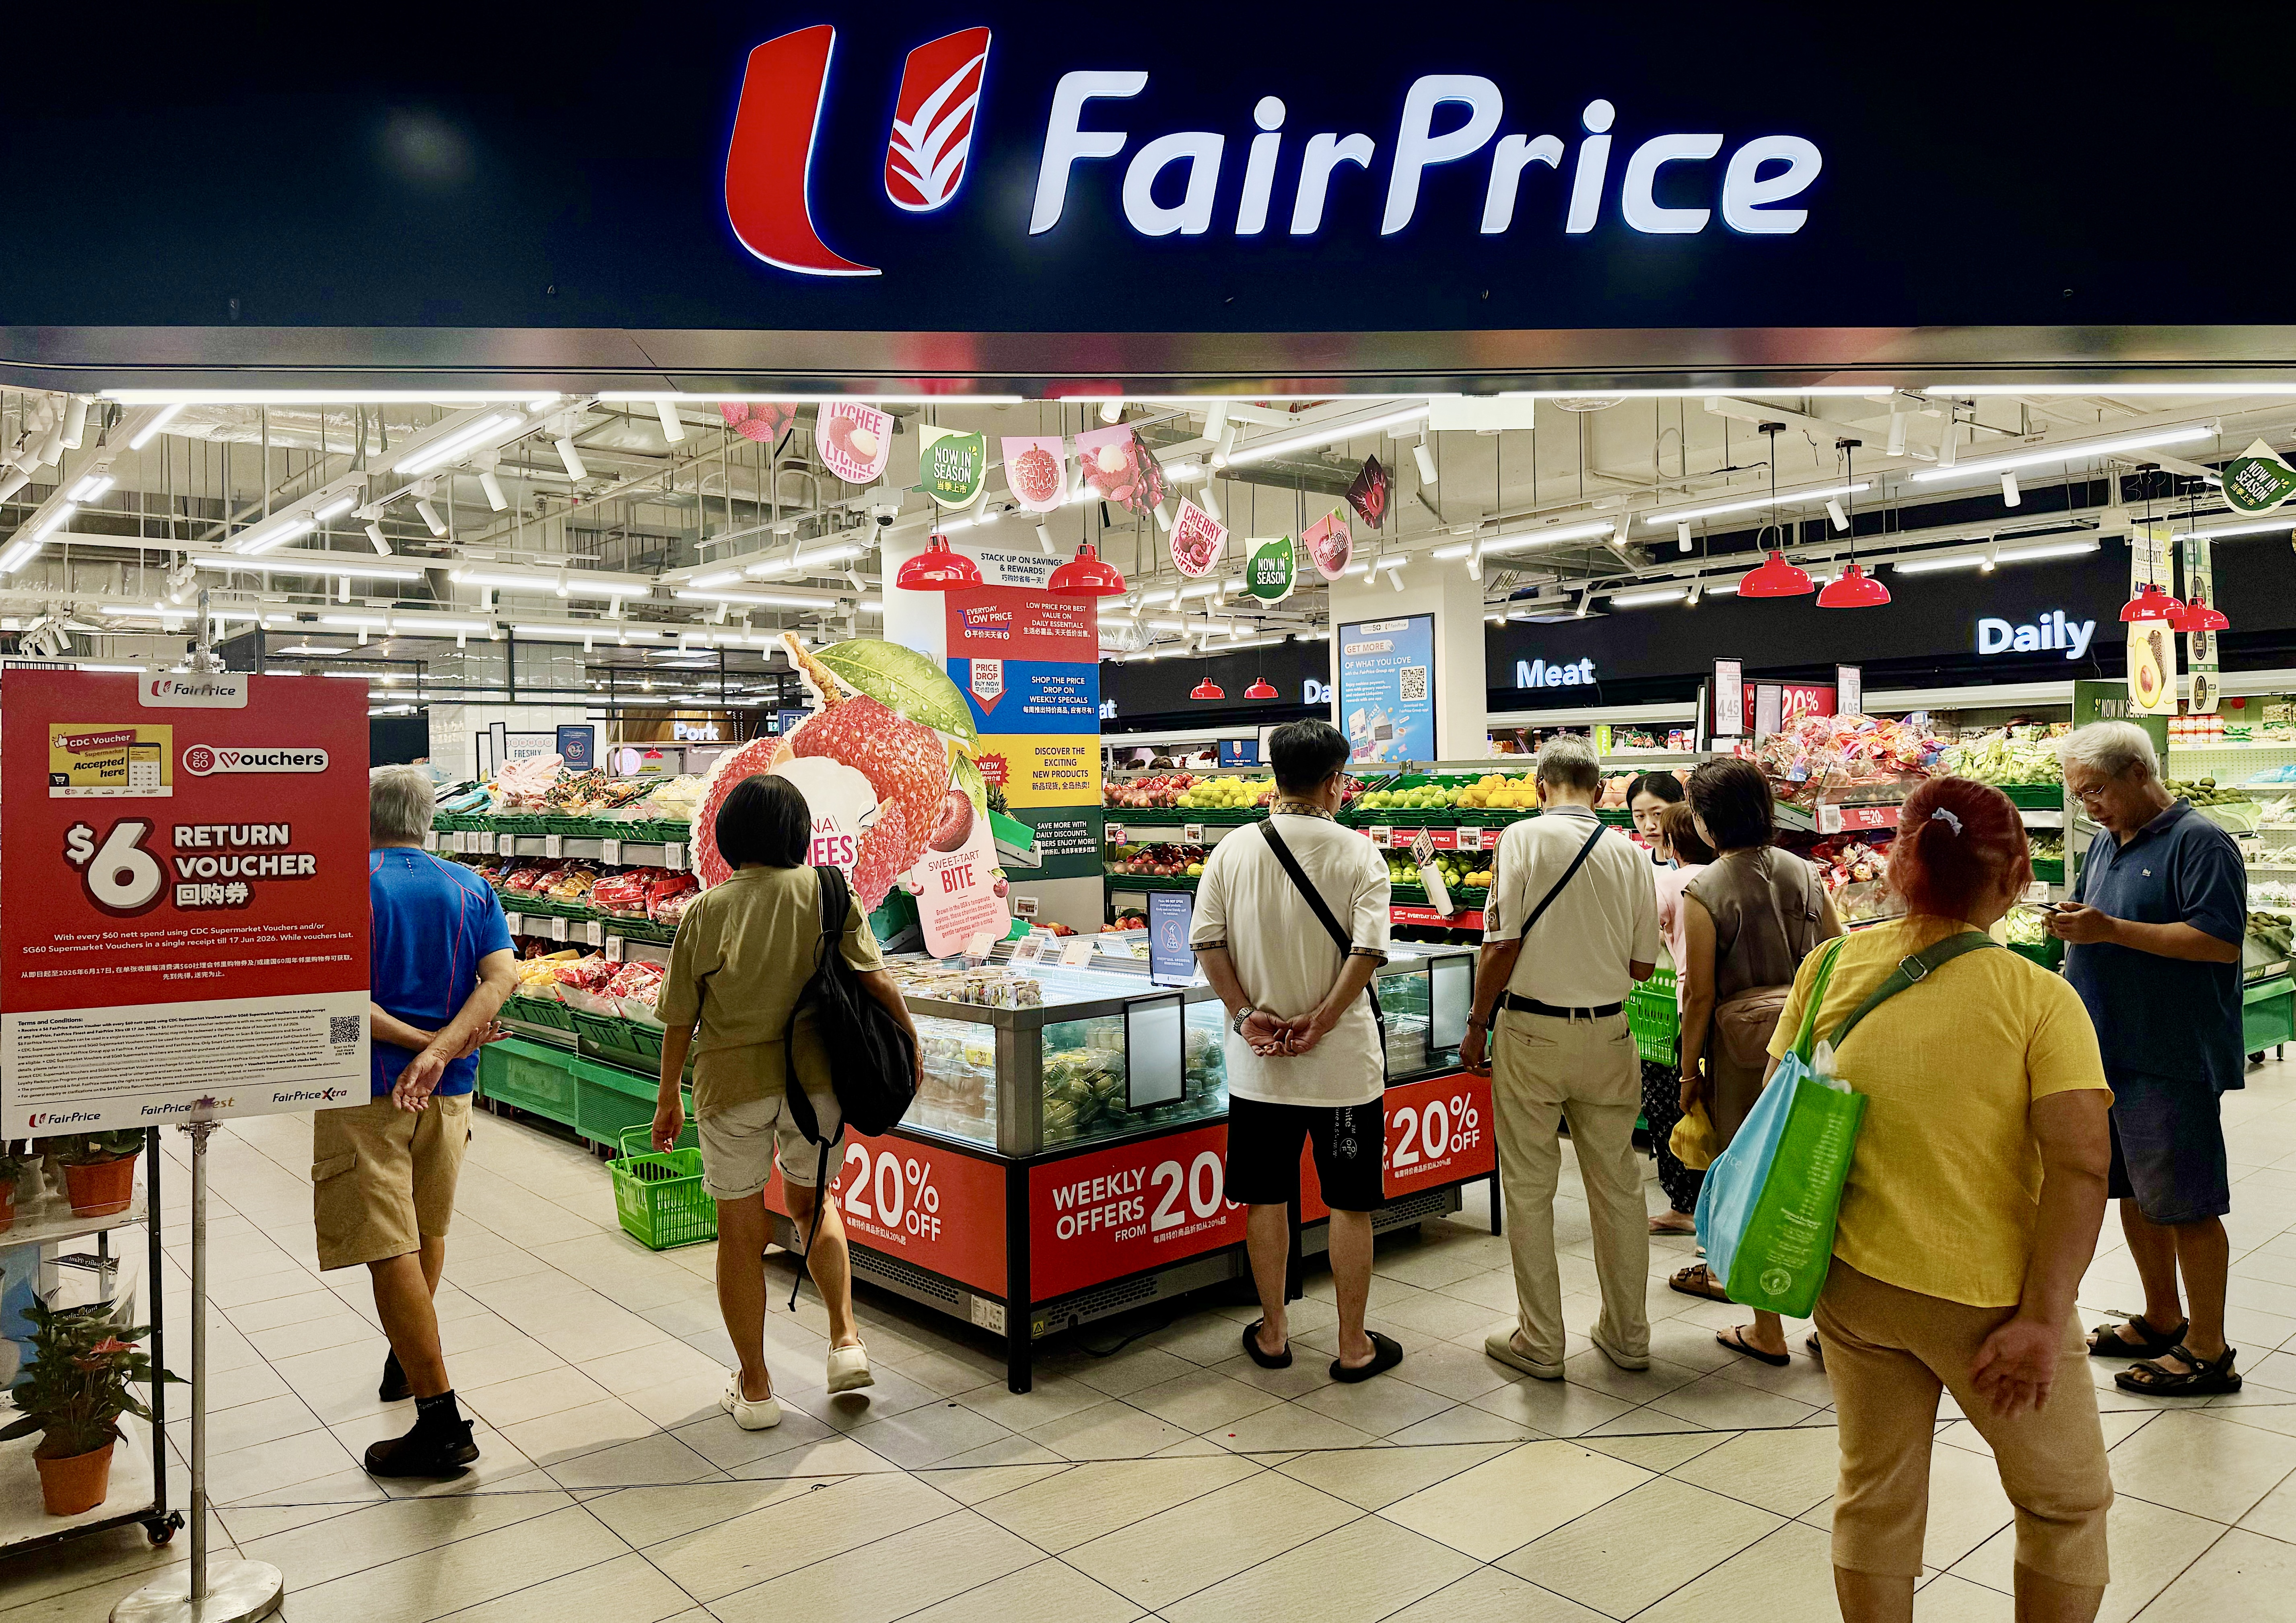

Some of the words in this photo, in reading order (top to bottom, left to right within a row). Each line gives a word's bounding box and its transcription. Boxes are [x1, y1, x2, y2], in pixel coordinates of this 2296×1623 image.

[1028, 70, 1822, 236] FairPrice
[831, 402, 882, 435] LYCHEE
[935, 447, 959, 464] NOW
[961, 451, 972, 467] IN
[934, 463, 971, 483] SEASON
[1008, 457, 1063, 490] 荔枝
[2246, 461, 2271, 483] NOW
[2264, 477, 2280, 492] IN
[937, 481, 968, 494] 当季上市
[2230, 482, 2256, 506] 当季上市
[2236, 470, 2270, 502] SEASON
[1184, 506, 1221, 541] CHERRY
[1313, 527, 1349, 567] CHERRY
[981, 553, 1005, 562] STACK
[1032, 557, 1063, 566] SAVINGS
[1258, 558, 1275, 571] NOW
[1277, 558, 1285, 571] IN
[1008, 565, 1045, 574] REWARDS!
[1257, 571, 1286, 585] SEASON
[966, 605, 997, 615] EVERYDAY
[968, 615, 987, 624] LOW
[990, 612, 1013, 621] PRICE
[972, 631, 1003, 639] 平价天天省
[1978, 610, 2096, 660] Daily
[1363, 642, 1384, 652] MORE
[1355, 660, 1375, 668] WHAT
[1393, 656, 1411, 664] LOVE
[1517, 657, 1595, 688] Meat
[174, 684, 235, 696] FairPrice
[1304, 680, 1331, 704] Da
[1099, 699, 1117, 719] at
[2101, 699, 2116, 718] NOW
[2117, 699, 2124, 718] IN
[70, 738, 90, 747] CDC
[93, 734, 130, 744] Voucher
[674, 724, 719, 741] Pork
[84, 749, 124, 757] Supermarket
[193, 751, 208, 760] SG
[74, 757, 124, 770] Accepted
[193, 759, 208, 768] 60
[979, 762, 999, 770] NEW
[100, 769, 125, 778] here
[811, 818, 834, 833] NA
[175, 825, 289, 847] RETURN
[807, 835, 853, 867] EES
[66, 822, 161, 909] $6
[176, 855, 316, 878] VOUCHER
[929, 850, 979, 872] SWEET-TART
[941, 863, 976, 894] BITE
[176, 882, 249, 906] 回购券
[971, 896, 990, 905] temperate
[950, 919, 965, 927] balance
[970, 912, 990, 921] sweetness
[962, 907, 977, 916] cherries
[77, 933, 100, 941] every
[140, 930, 165, 938] spend
[211, 926, 261, 935] Supermarket
[942, 930, 954, 938] gentle
[955, 925, 971, 933] tartness
[49, 944, 103, 953] Supermarket
[162, 940, 185, 948] single
[187, 937, 215, 946] receipt
[273, 1091, 321, 1103] FairPrice
[321, 1087, 347, 1101] Xtra
[48, 1113, 101, 1124] FairPrice
[141, 1104, 192, 1115] FairPrice
[1393, 1092, 1478, 1168] 20%
[1450, 1129, 1480, 1153] OFF
[845, 1142, 939, 1228] 20%
[1052, 1167, 1146, 1211] WEEKLY
[1151, 1151, 1246, 1232] 20
[906, 1209, 941, 1242] OFF
[1056, 1196, 1144, 1240] OFFERS
[1115, 1224, 1146, 1242] FROM
